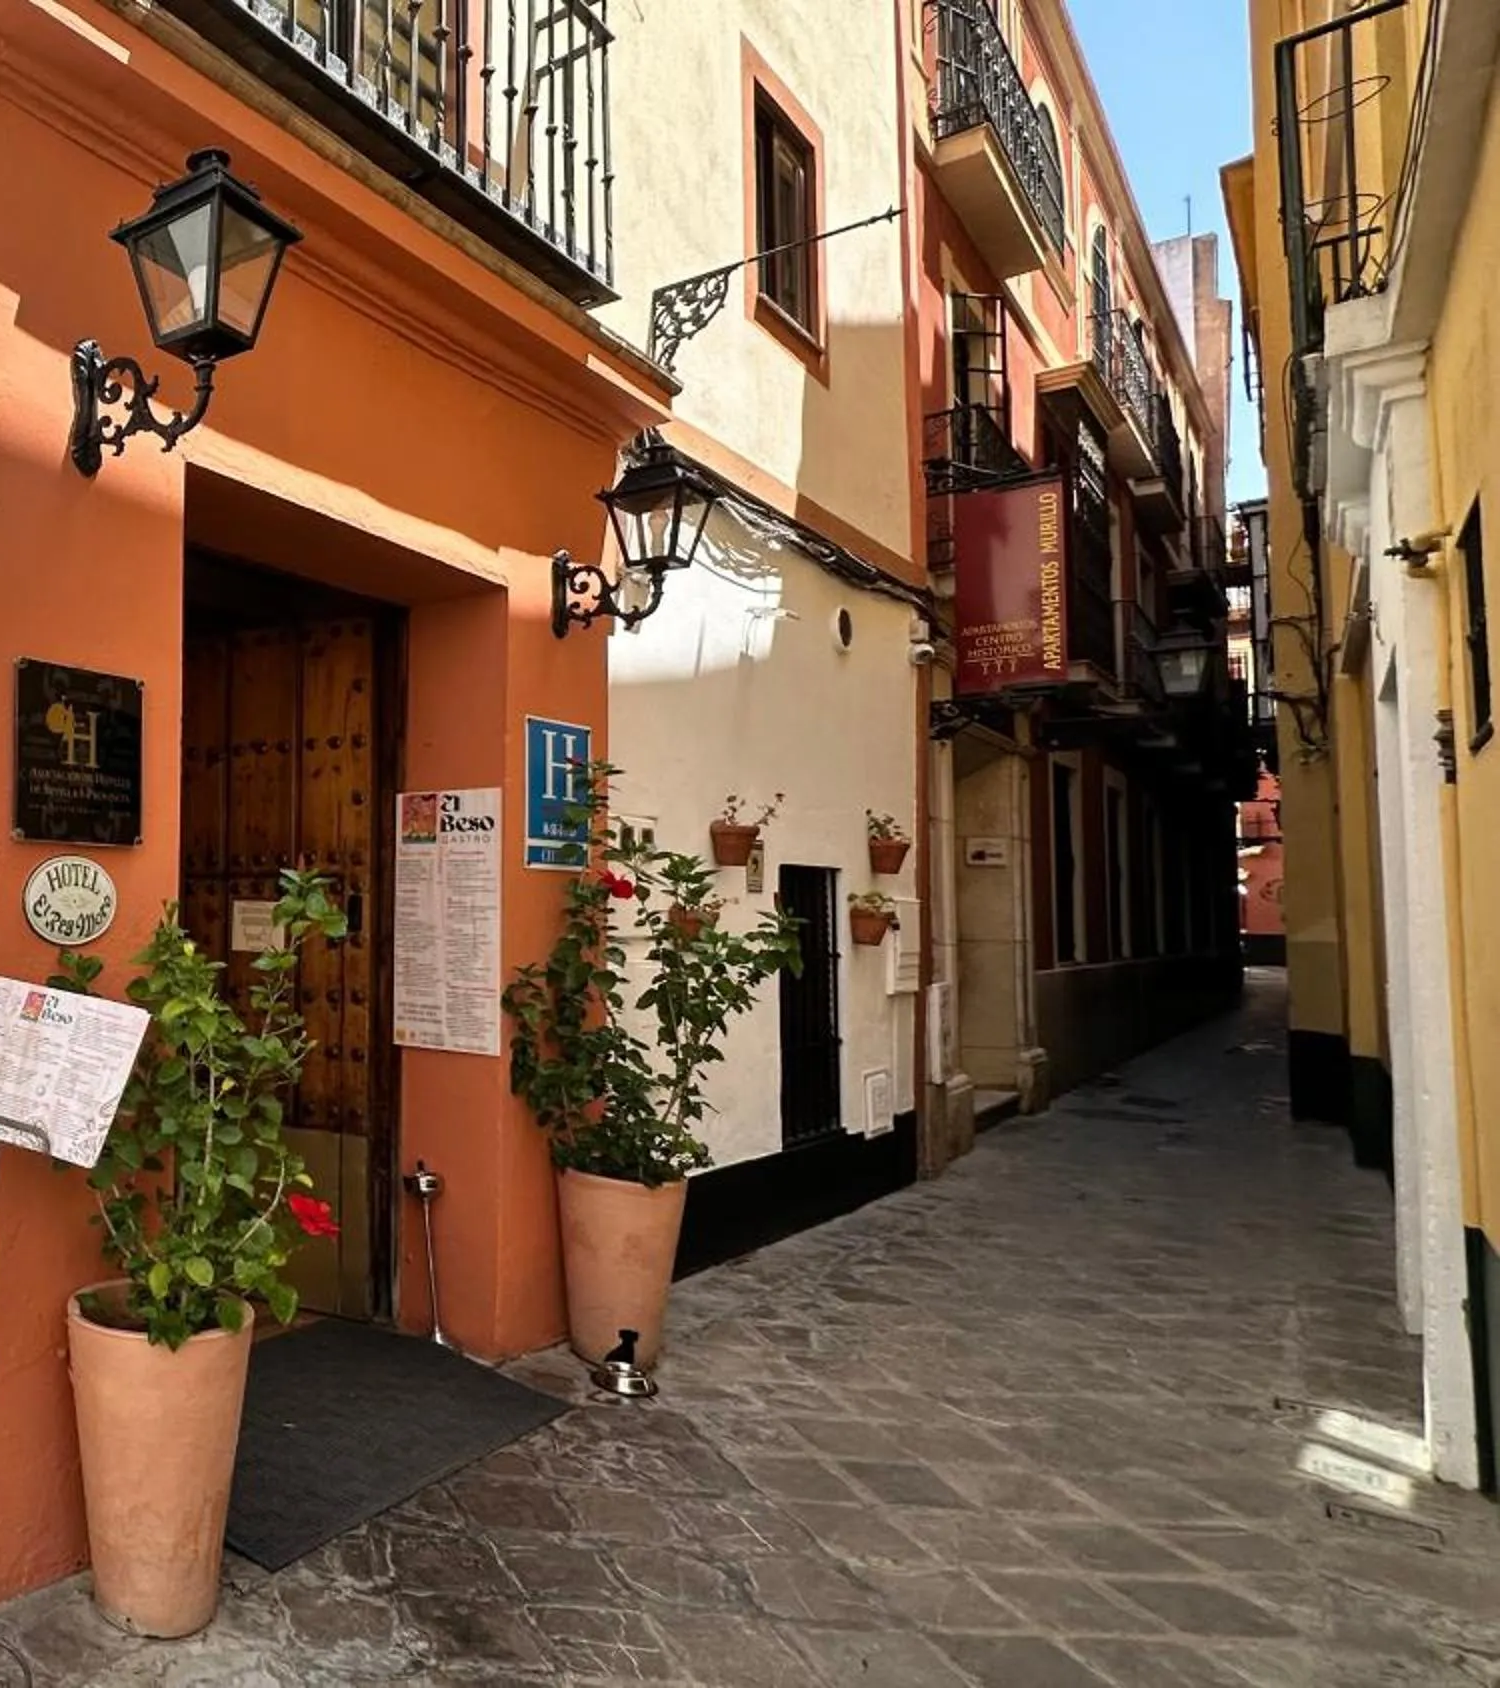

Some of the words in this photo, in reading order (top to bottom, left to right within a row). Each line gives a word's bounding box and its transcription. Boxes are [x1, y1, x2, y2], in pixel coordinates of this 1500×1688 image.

[1039, 492, 1059, 553] MURILLO
[1041, 560, 1061, 670] APARTAMENTOS
[975, 632, 1023, 647] CENTRO
[541, 729, 577, 803] H
[440, 813, 495, 833] Beso
[46, 863, 100, 896] HOTEL
